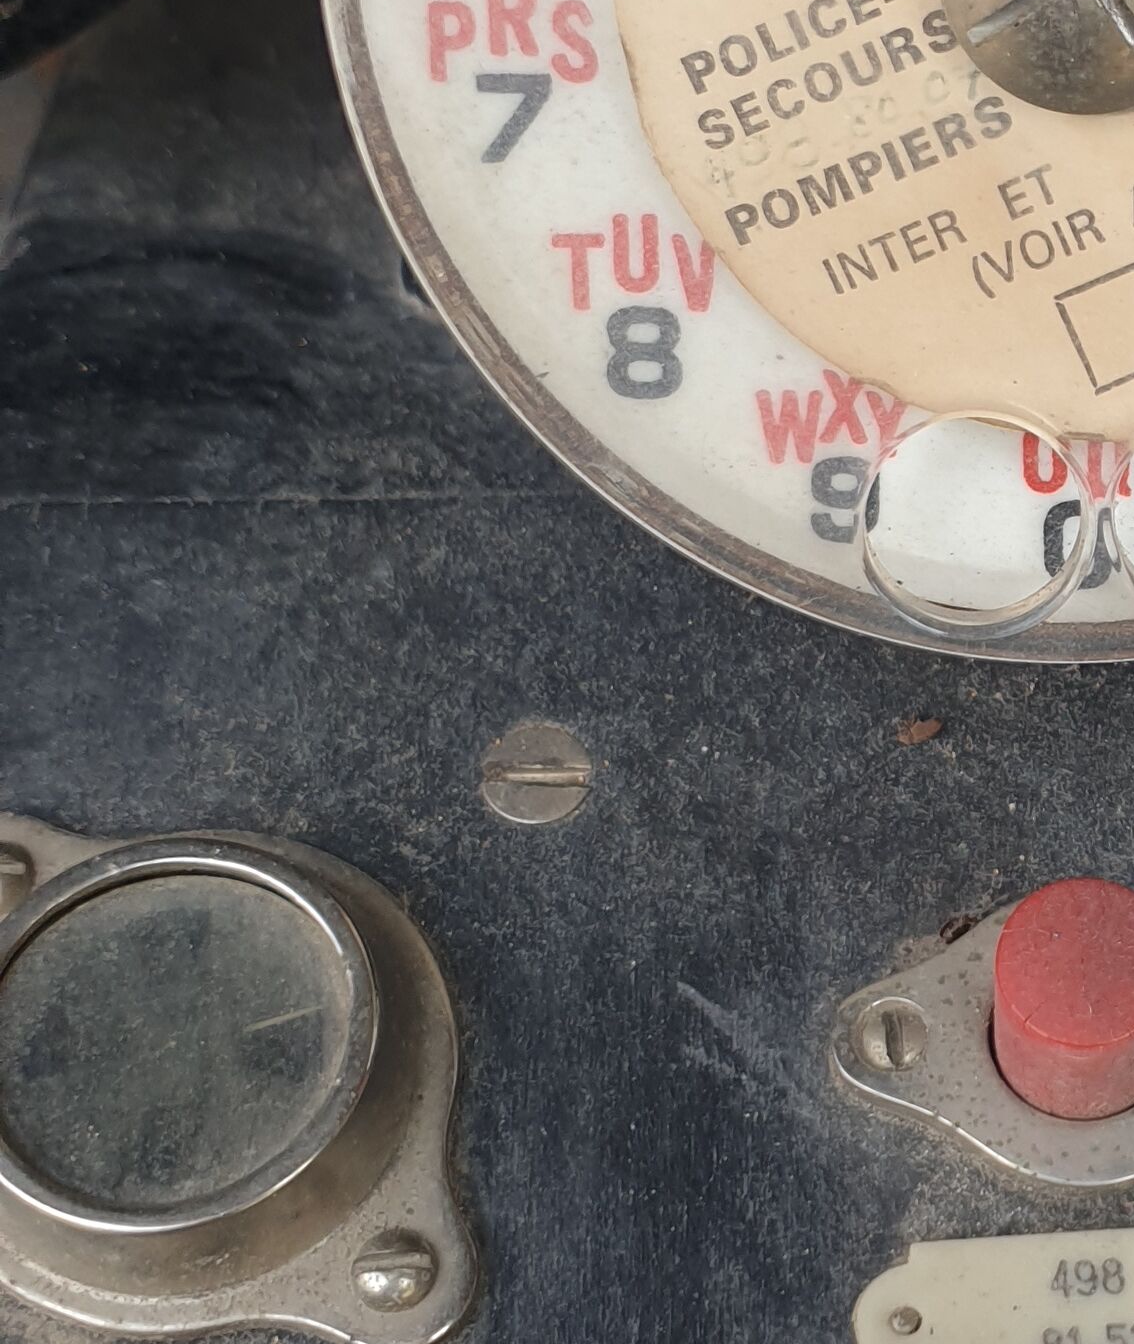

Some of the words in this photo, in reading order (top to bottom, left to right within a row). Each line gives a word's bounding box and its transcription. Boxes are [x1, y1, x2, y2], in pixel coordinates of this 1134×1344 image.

[476, 72, 553, 164] 7
[697, 8, 959, 150] SECOURS
[724, 95, 1014, 246] POMPIERS
[552, 213, 715, 311] TUV
[821, 208, 968, 296] INTER
[997, 163, 1057, 221] ET
[972, 207, 1106, 299] (VOIR
[606, 305, 684, 399] 8
[756, 369, 907, 465] WXY
[810, 455, 881, 544] 9
[1043, 499, 1114, 590] 0
[1050, 1257, 1126, 1299] 498
